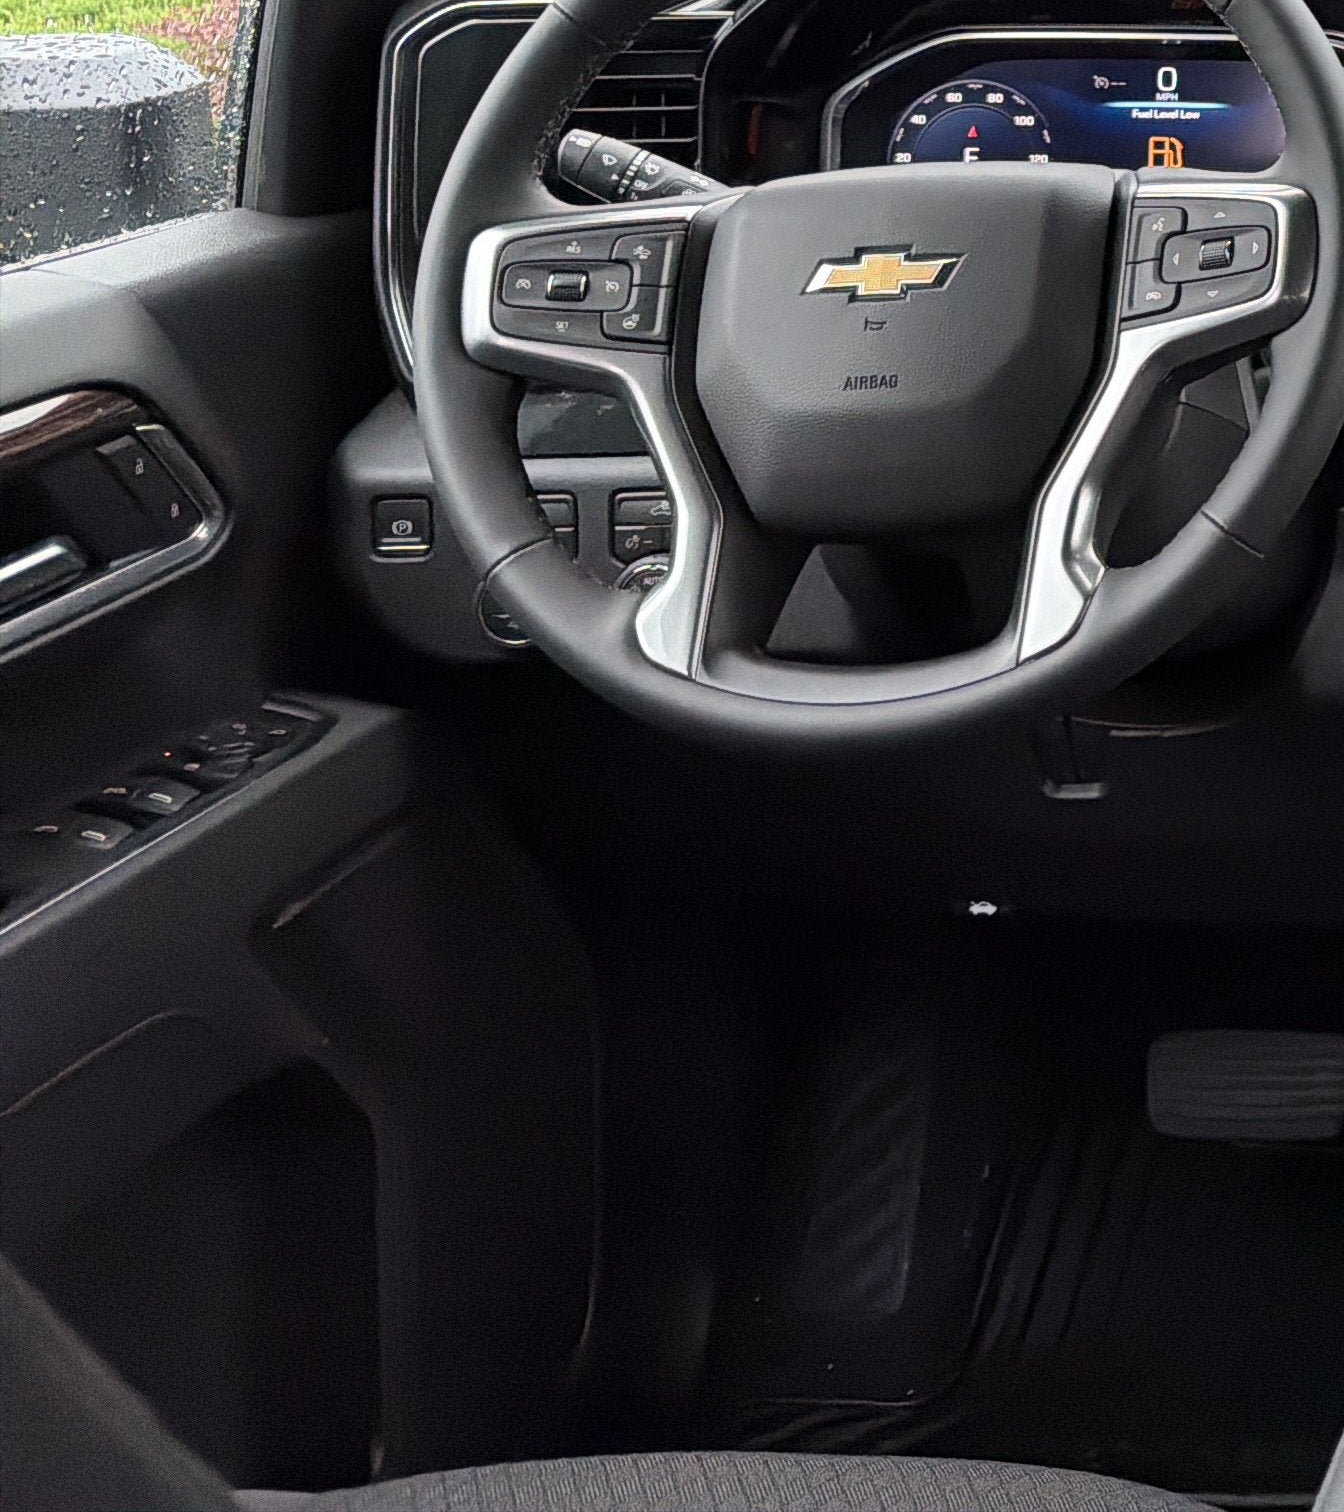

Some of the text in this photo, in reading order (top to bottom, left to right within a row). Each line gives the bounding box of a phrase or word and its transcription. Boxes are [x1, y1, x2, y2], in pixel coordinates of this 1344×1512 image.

[1156, 66, 1177, 92] 0
[945, 92, 962, 103] 60
[986, 92, 1004, 103] 80
[1155, 92, 1179, 102] MPH
[910, 114, 927, 125] 40
[1131, 109, 1201, 120] Fuel Level Low
[1013, 116, 1035, 126] 100
[895, 153, 912, 163] 20
[842, 374, 899, 391] AIRBAG
